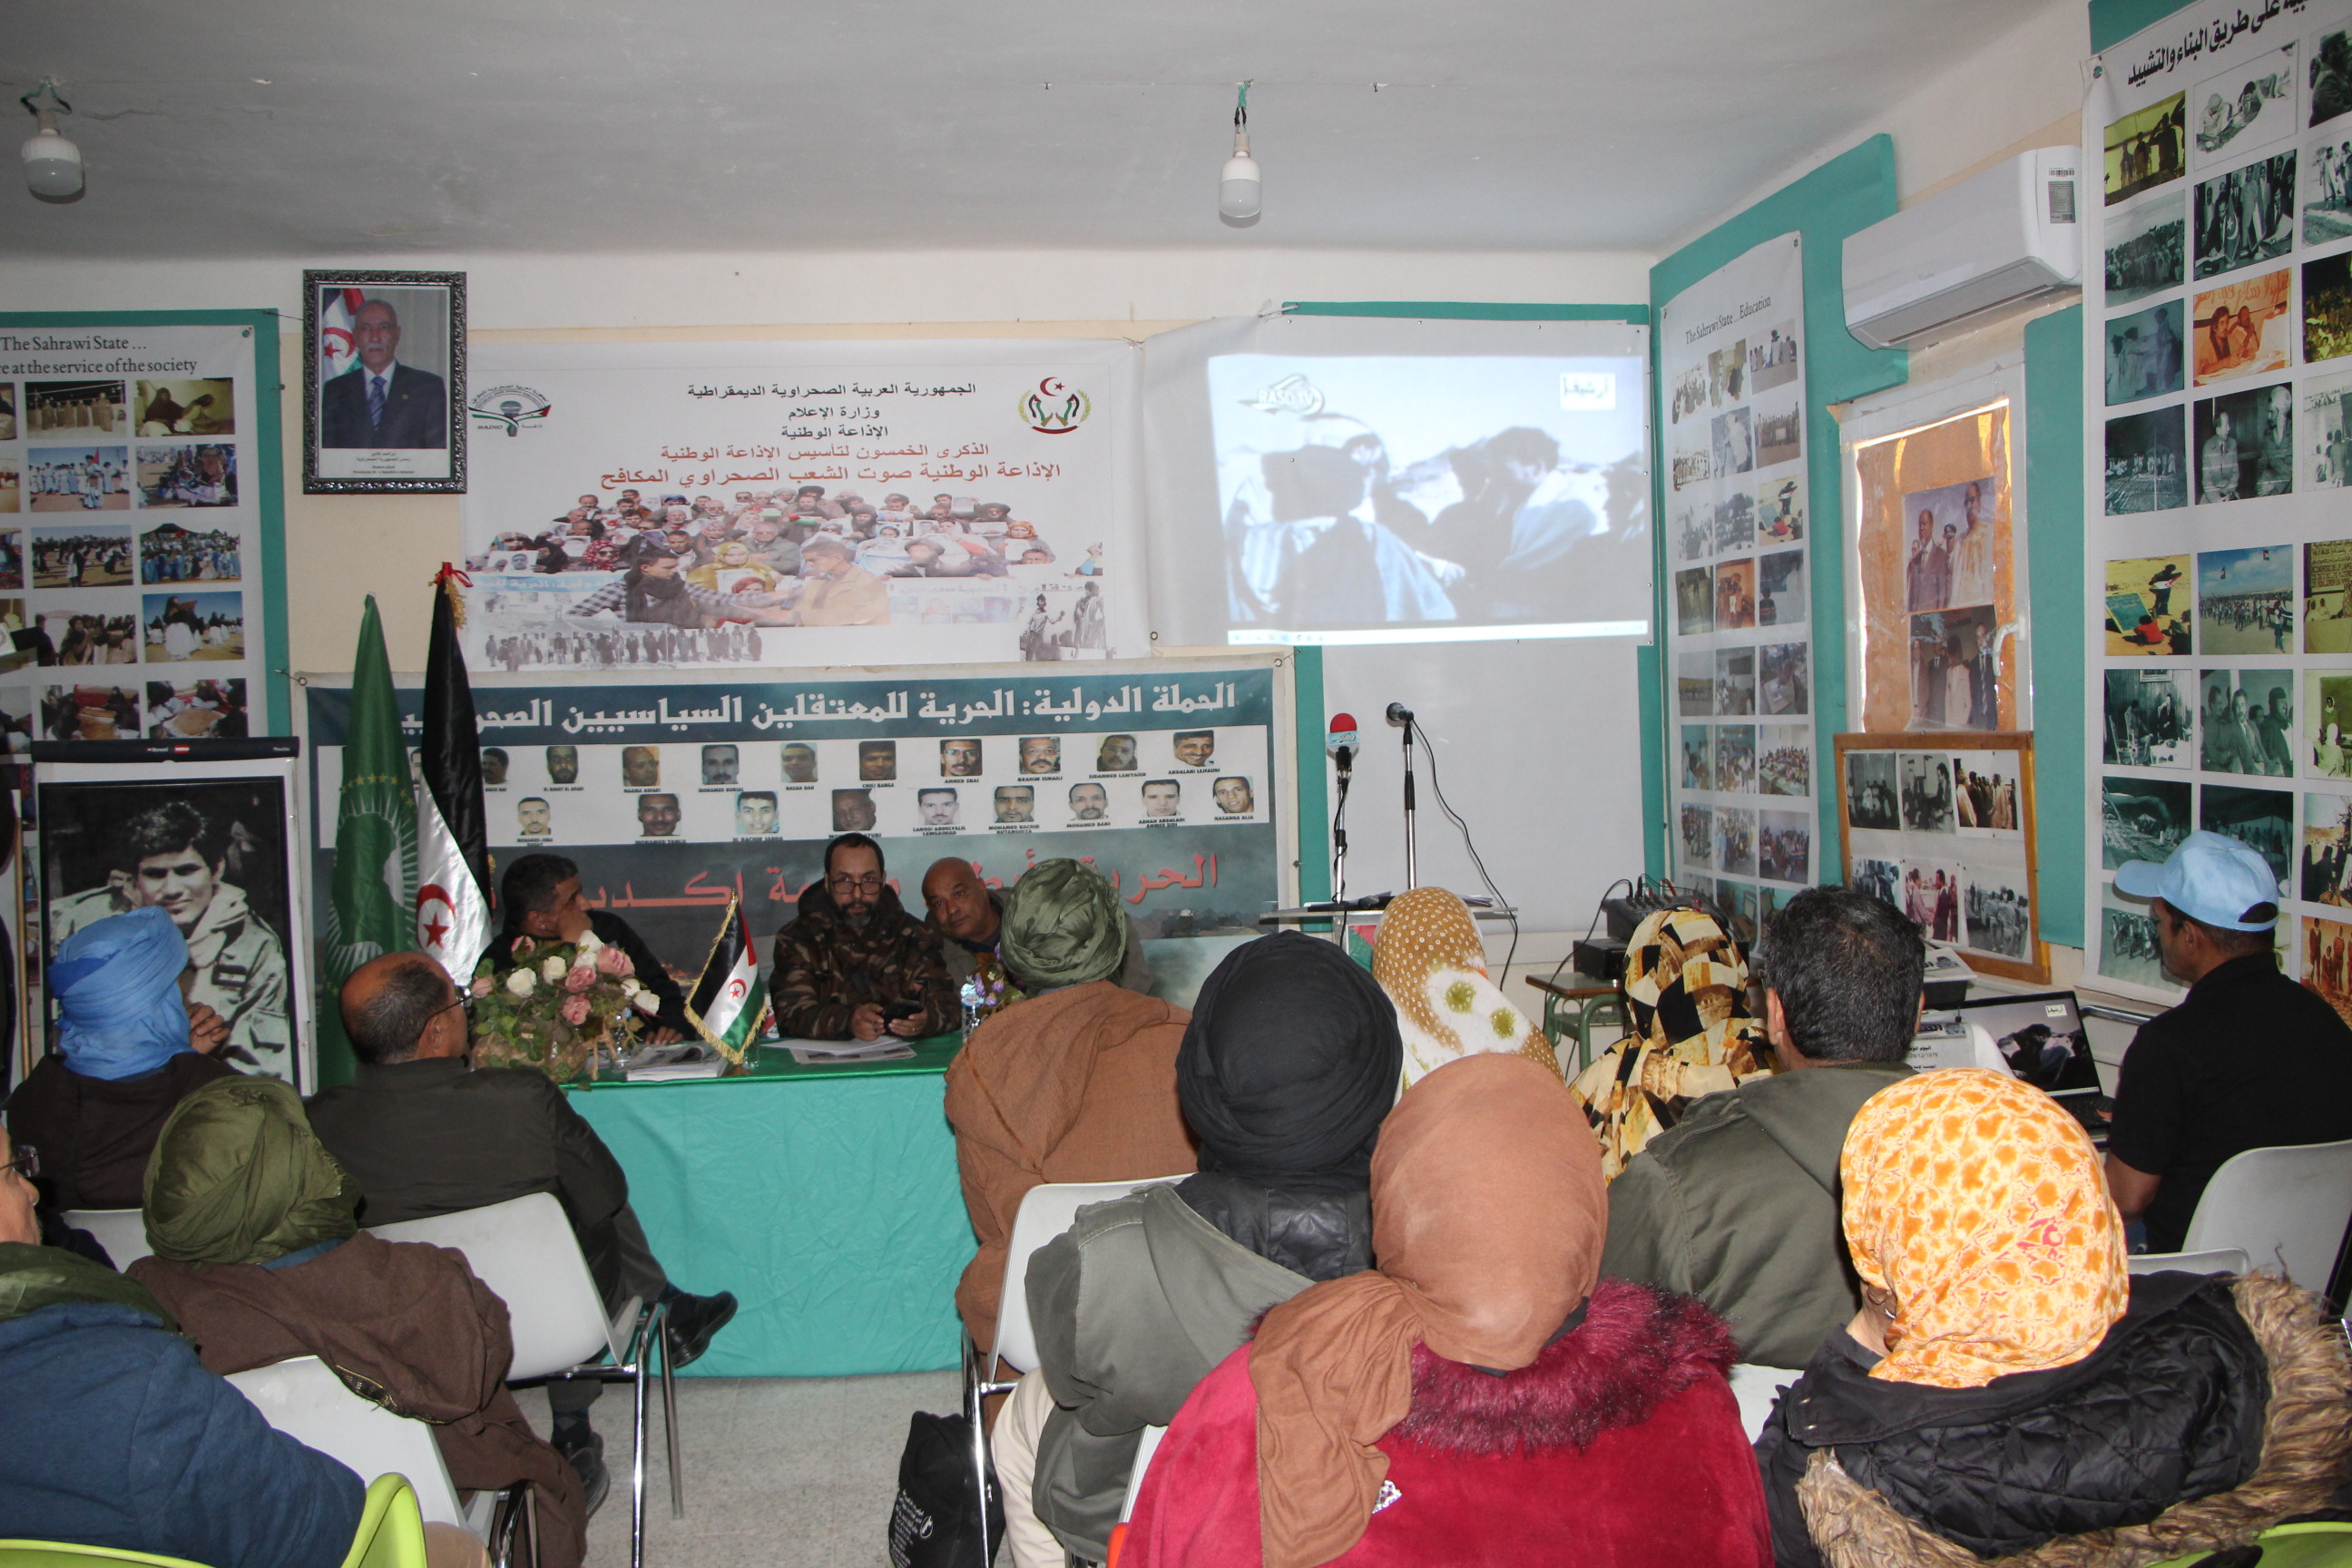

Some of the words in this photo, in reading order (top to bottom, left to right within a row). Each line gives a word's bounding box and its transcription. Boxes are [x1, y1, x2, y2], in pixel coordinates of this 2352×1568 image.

[2209, 8, 2249, 53] طريق
[2177, 26, 2208, 61] البناء
[1685, 330, 1696, 345] The
[1696, 317, 1719, 339] Sahrawi
[1719, 314, 1733, 329] State
[1740, 296, 1771, 318] Education
[1, 336, 30, 351] The
[33, 335, 92, 351] Sahrawi
[93, 336, 129, 350] State
[12, 363, 25, 375] at
[27, 358, 51, 375] the
[53, 360, 103, 374] service
[106, 358, 125, 373] of
[125, 358, 146, 372] the
[147, 358, 198, 375] society
[688, 384, 766, 399] الديمقراطية
[771, 384, 847, 399] الصحراوية
[851, 382, 898, 397] العربية
[904, 382, 976, 397] الجمهورية
[788, 406, 834, 421] الإعلام
[839, 406, 880, 419] وزارة
[781, 426, 832, 440] الوطنية
[838, 424, 888, 440] الإذاعة
[661, 446, 720, 463] الوطنية
[726, 445, 780, 462] الإذاعة
[788, 443, 849, 461] لتأسيس
[856, 443, 928, 459] الخمسون
[936, 442, 989, 458] الذكرى
[601, 466, 669, 490] المكافح
[679, 466, 779, 489] الصحراوي
[789, 465, 848, 484] الشعب
[858, 466, 913, 483] صوت
[919, 462, 989, 482] الوطنية
[996, 461, 1061, 482] الإذاعة
[1152, 681, 1235, 714] الحملة
[562, 694, 742, 734] السياسيين
[751, 690, 908, 730] للمعتقلين
[918, 688, 1014, 725] الحرية
